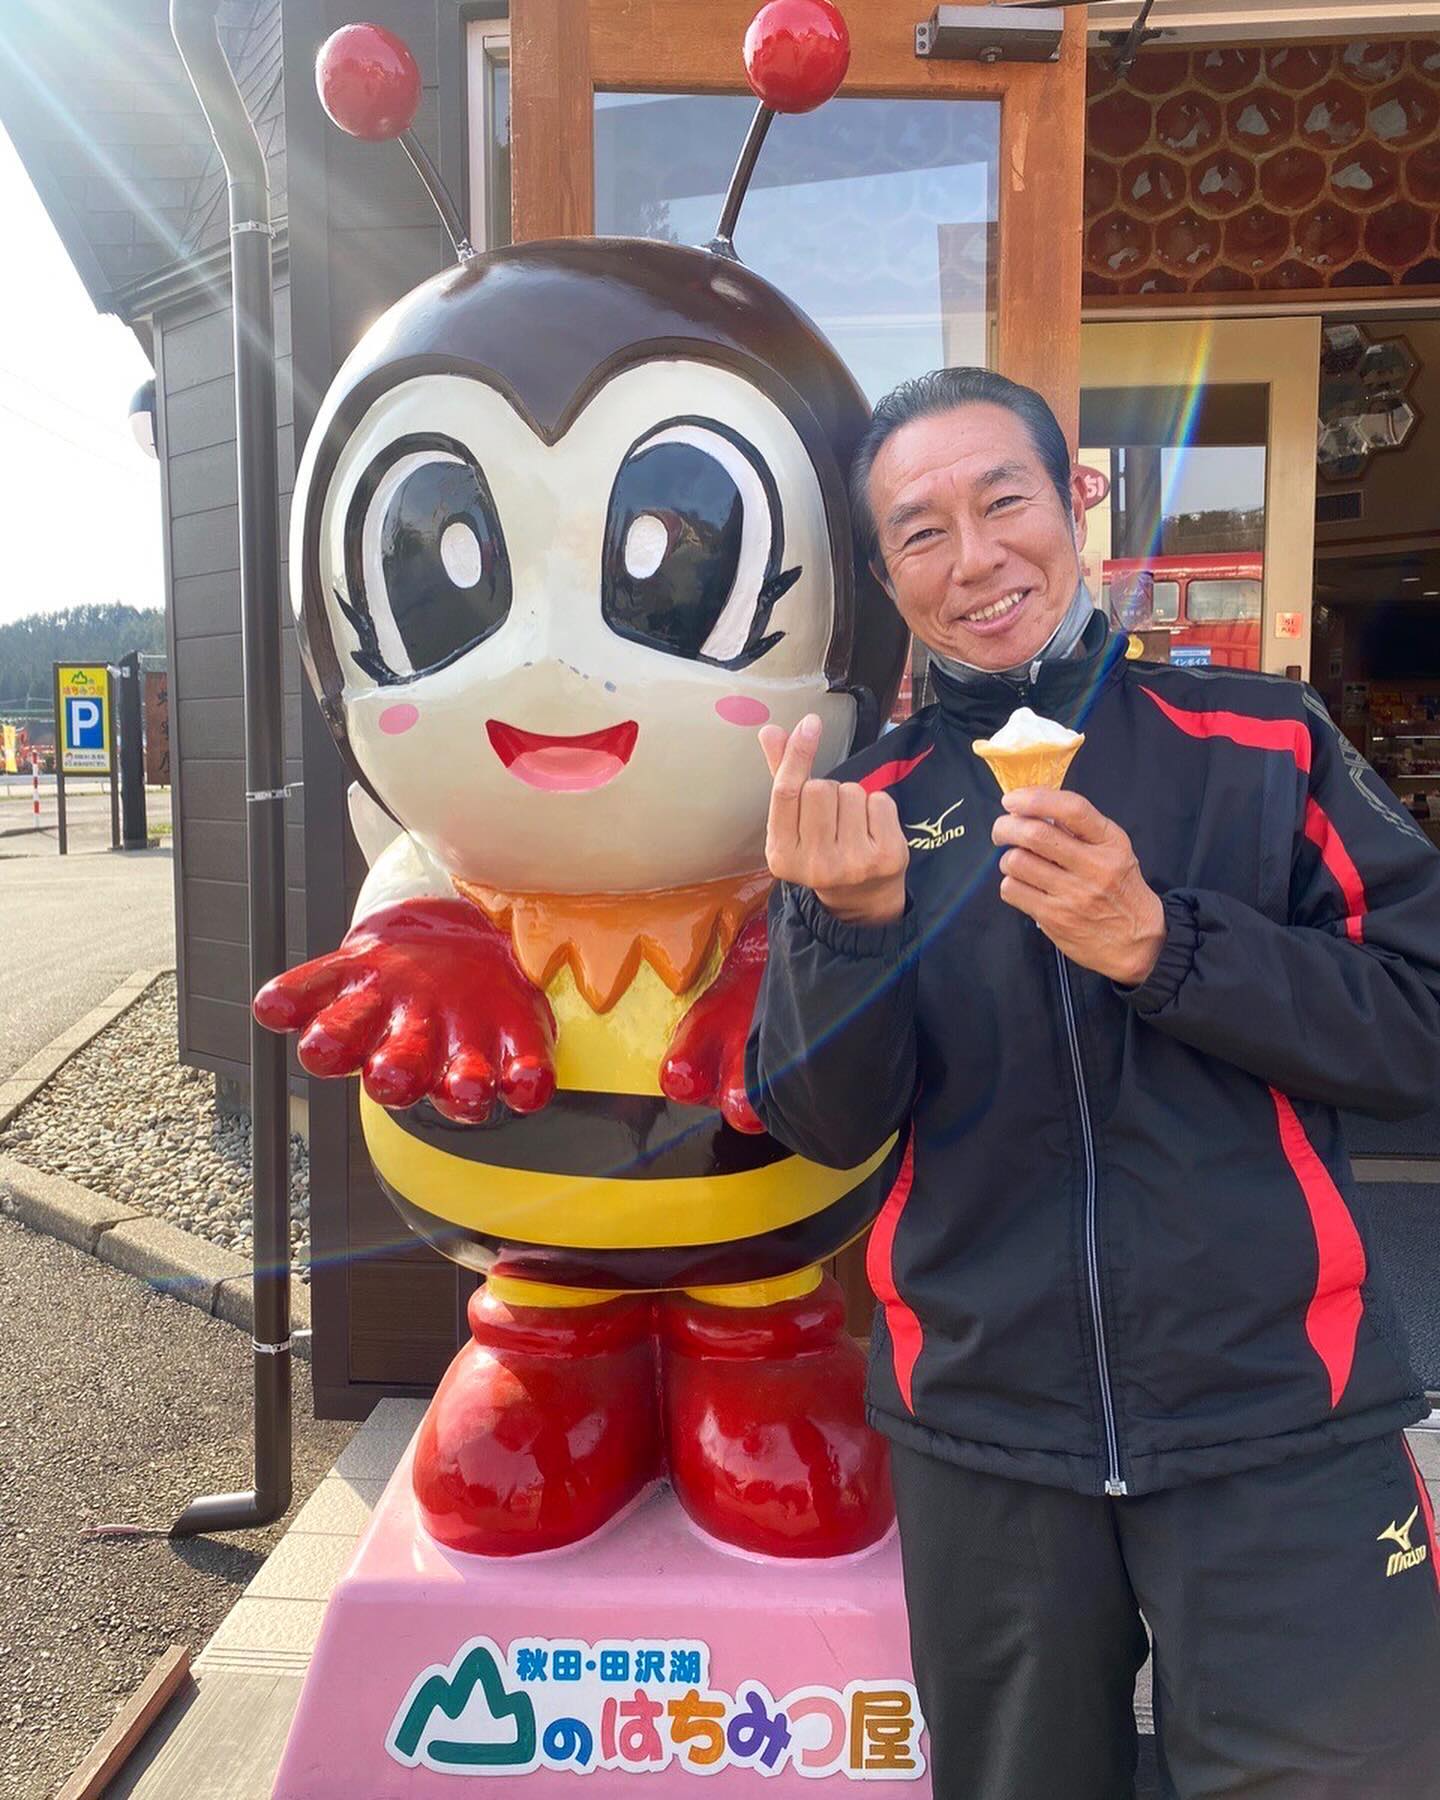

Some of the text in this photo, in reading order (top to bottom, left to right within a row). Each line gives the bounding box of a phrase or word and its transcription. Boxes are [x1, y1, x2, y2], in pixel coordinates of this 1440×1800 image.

[72, 700, 99, 746] P
[516, 1648, 701, 1684] 秋田・田沢湖
[394, 1646, 917, 1770] 山のはちみつ屋
